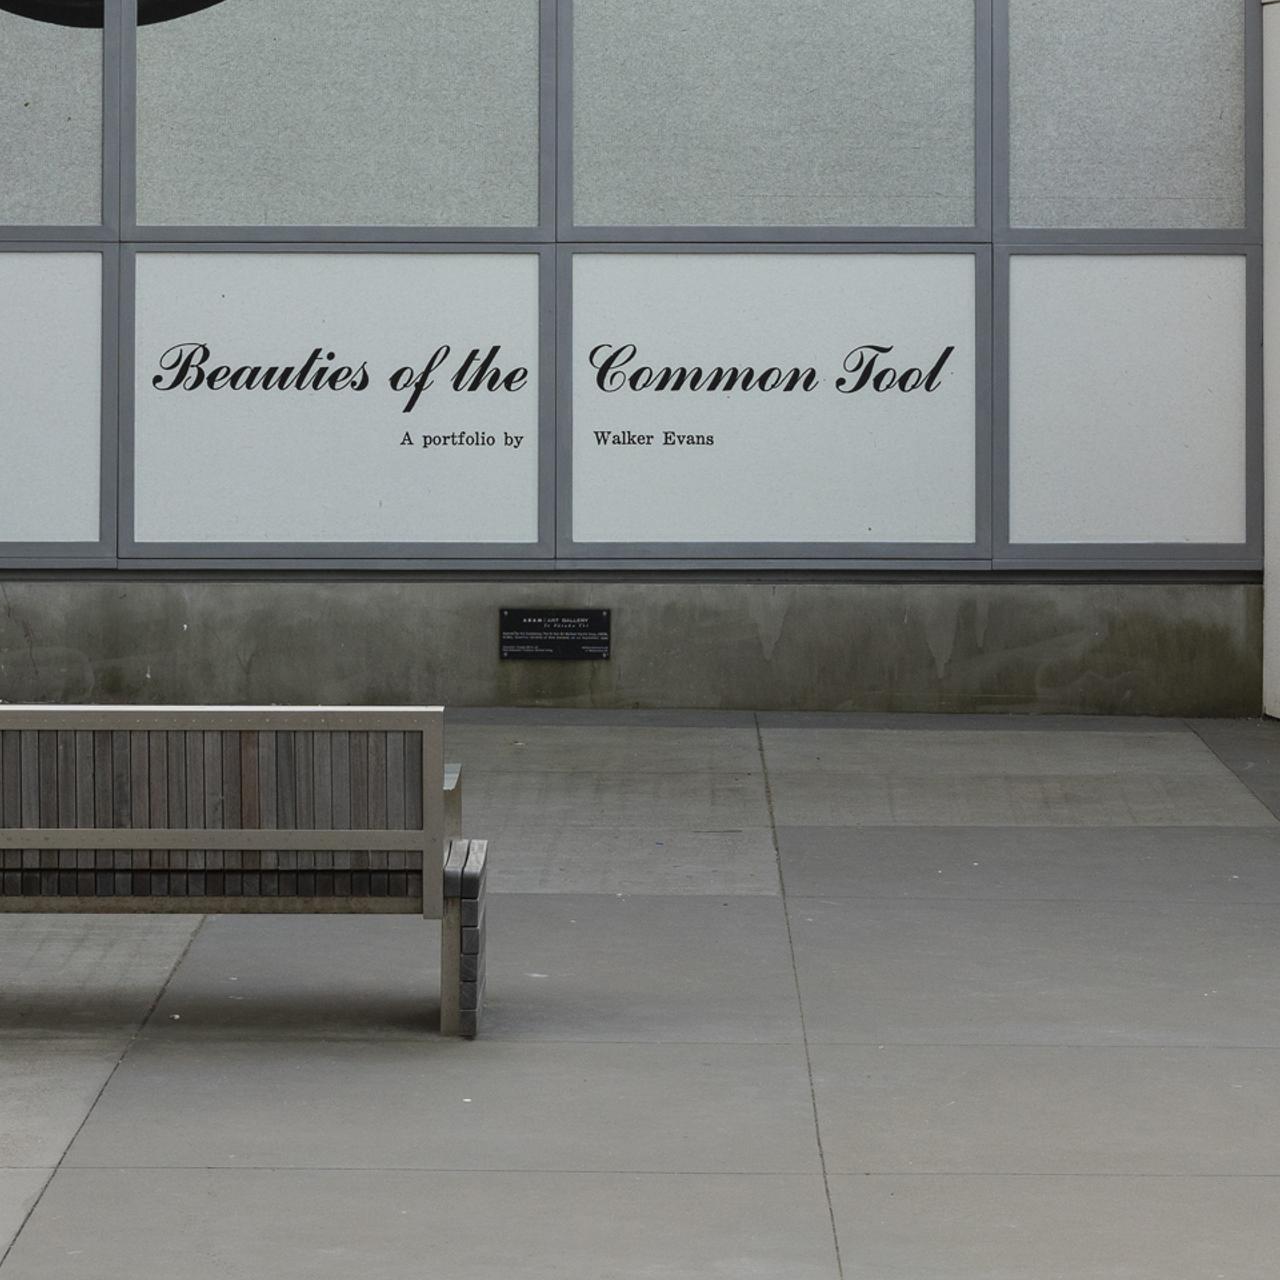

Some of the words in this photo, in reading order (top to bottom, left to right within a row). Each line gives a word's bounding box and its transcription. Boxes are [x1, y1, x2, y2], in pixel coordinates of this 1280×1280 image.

[152, 342, 370, 392] Beauties
[388, 344, 451, 414] of
[450, 345, 529, 392] the
[588, 343, 820, 393] Common
[834, 344, 956, 394] Tool
[399, 432, 414, 446] A
[422, 431, 496, 448] portfolio
[503, 431, 524, 449] by
[593, 430, 654, 446] Walker
[662, 431, 715, 446] Evans
